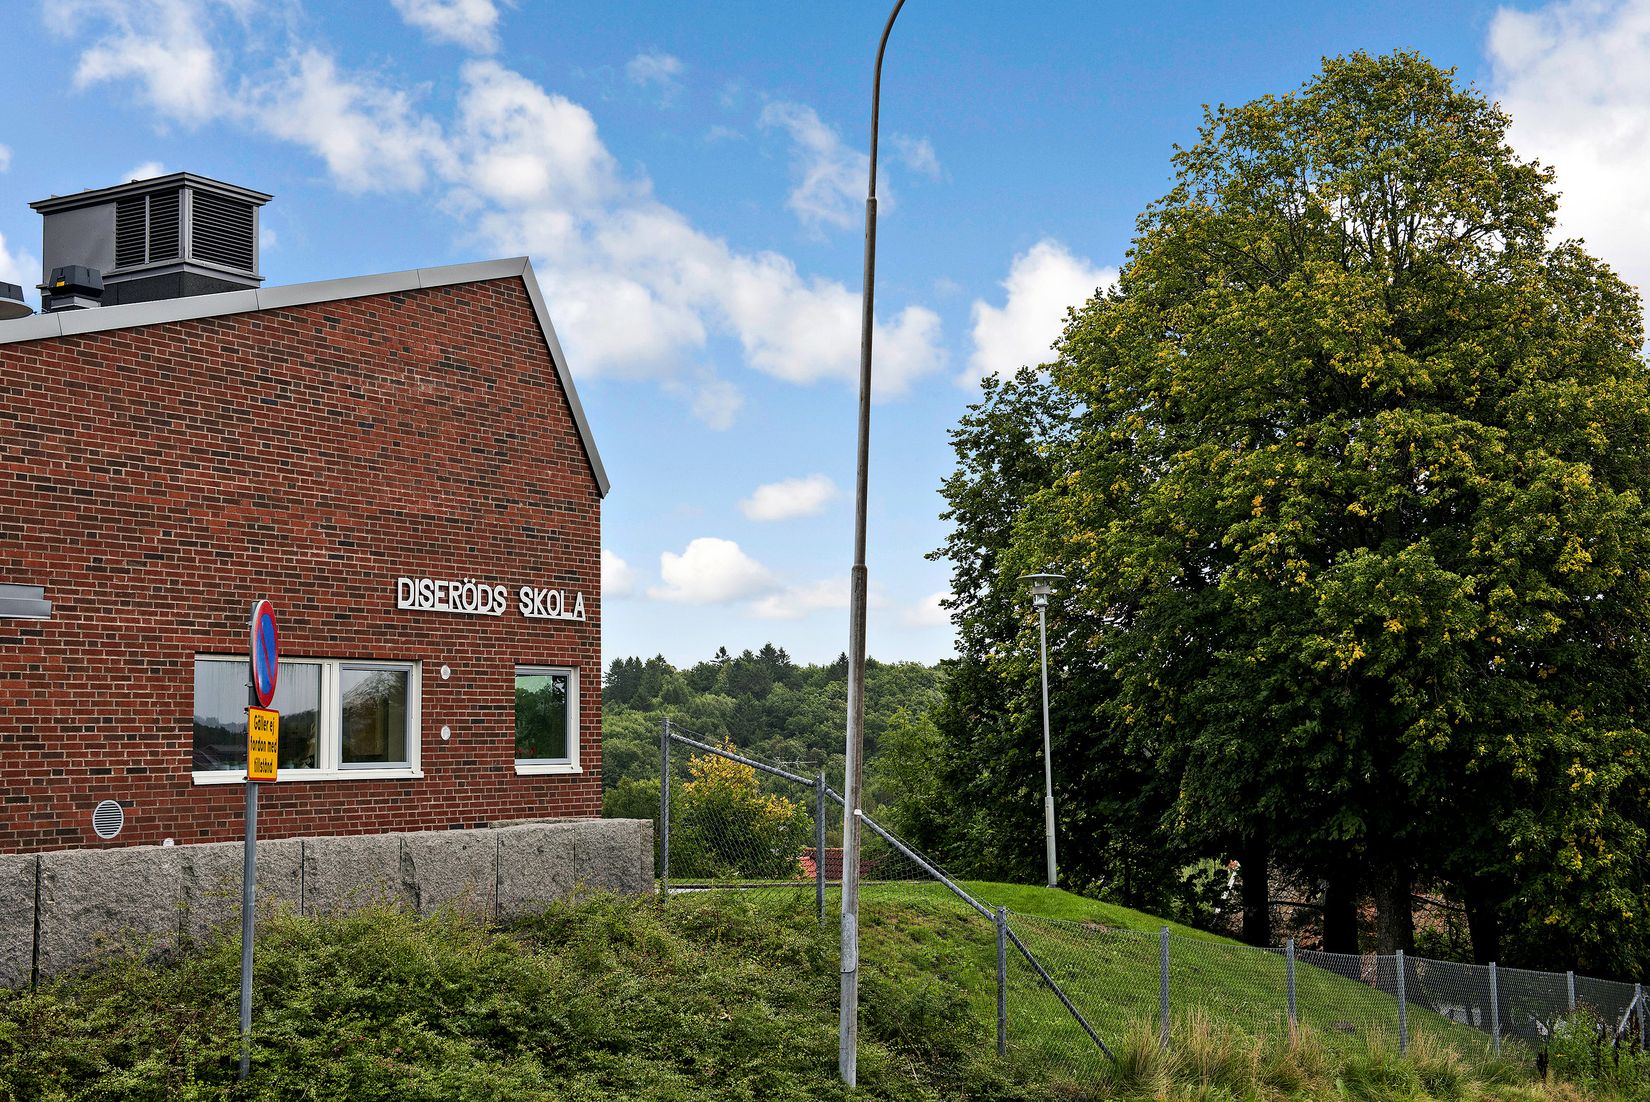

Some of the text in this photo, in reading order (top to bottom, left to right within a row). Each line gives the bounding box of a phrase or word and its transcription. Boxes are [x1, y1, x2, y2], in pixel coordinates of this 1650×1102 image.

[398, 577, 586, 621] DISERÖDS SKOLA
[269, 717, 275, 736] ej
[250, 735, 278, 753] fordon med
